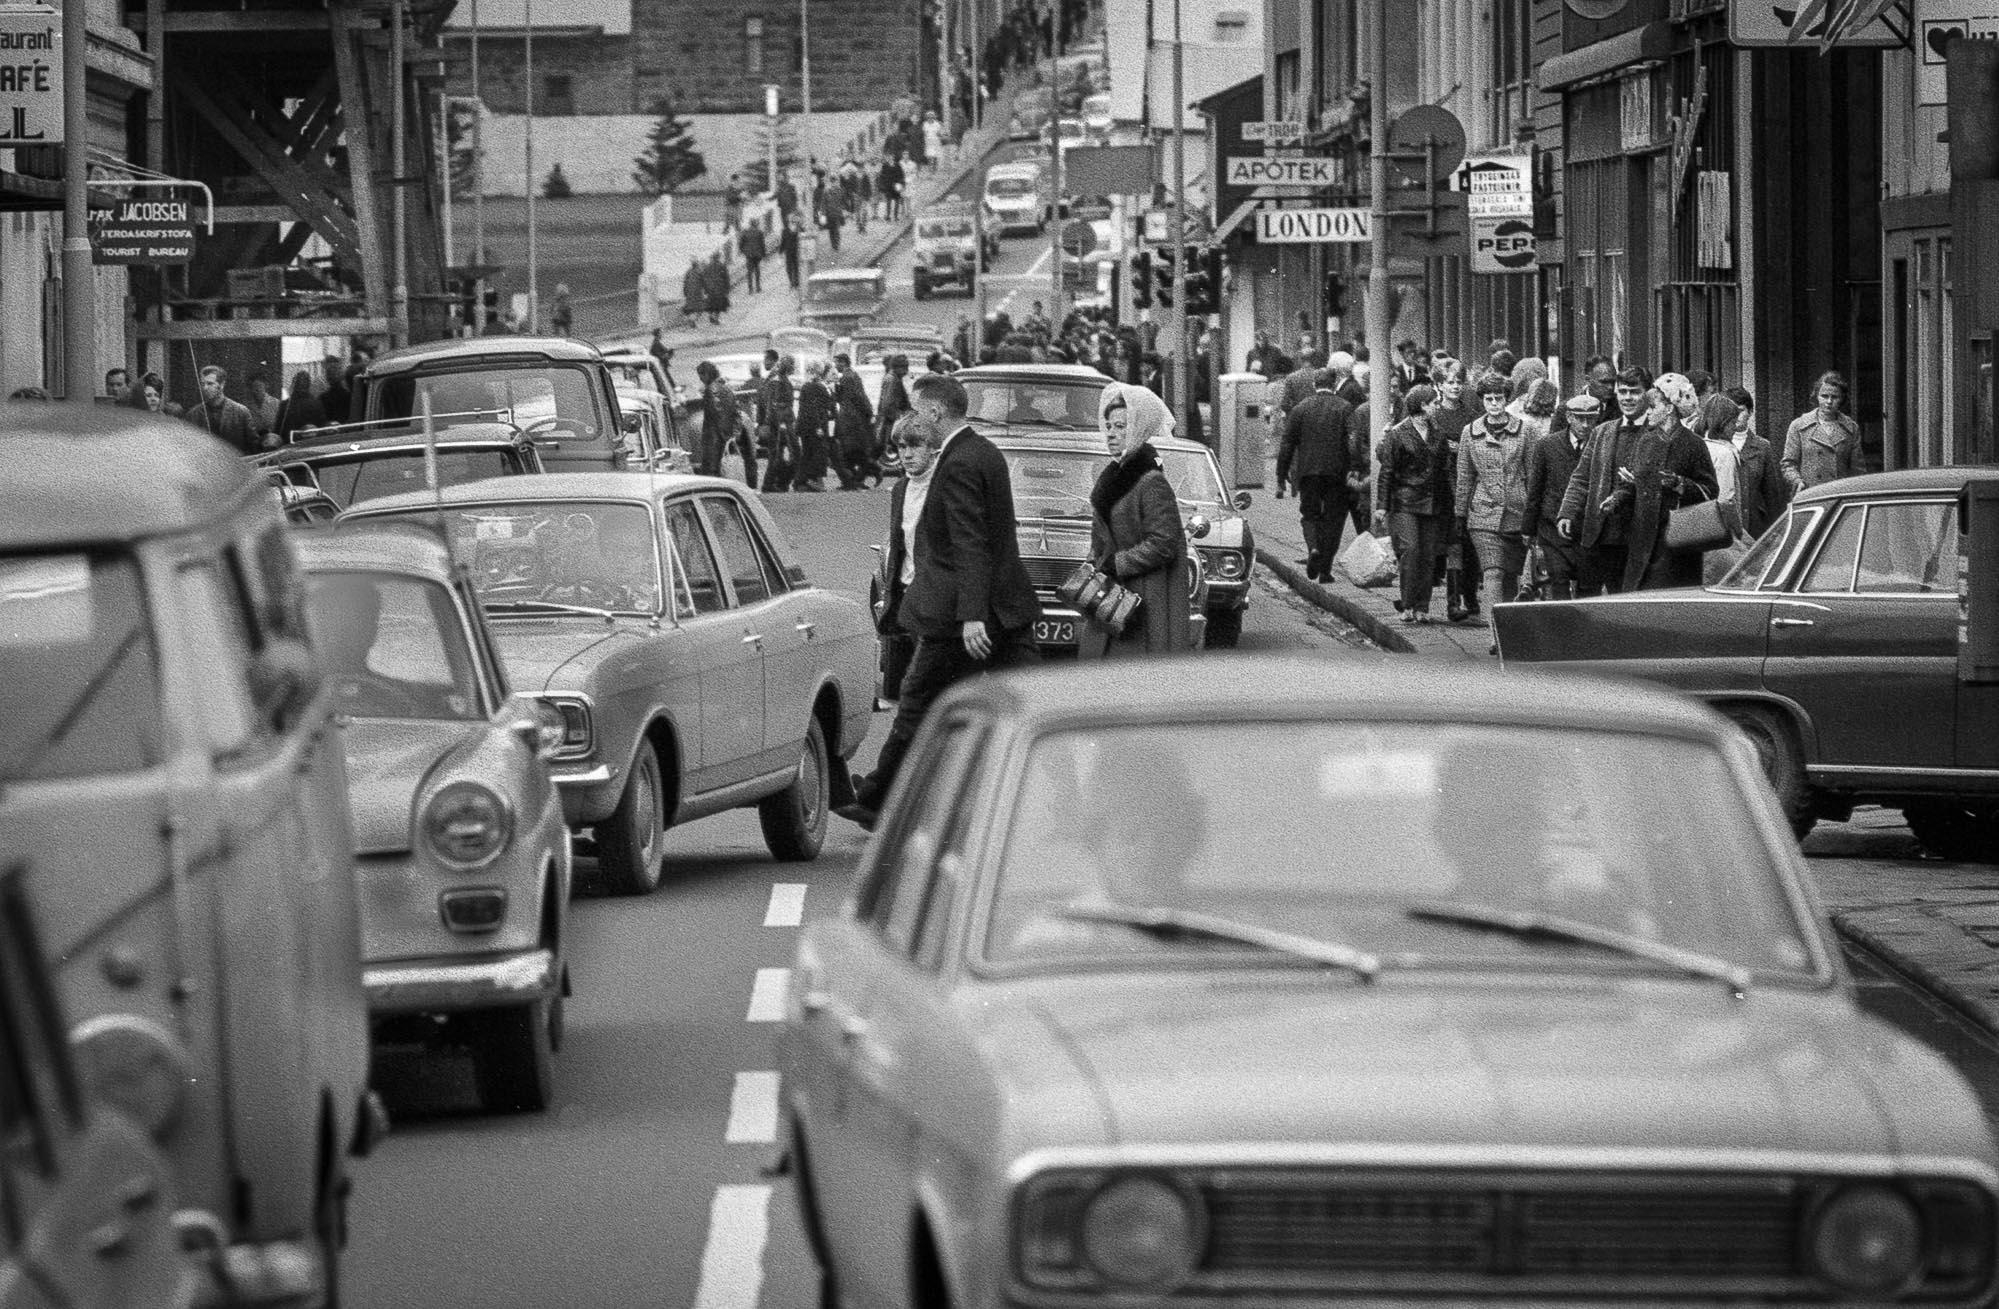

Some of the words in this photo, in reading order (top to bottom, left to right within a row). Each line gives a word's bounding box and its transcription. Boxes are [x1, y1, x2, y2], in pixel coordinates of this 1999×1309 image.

[0, 26, 54, 49] aurant
[1234, 157, 1329, 180] APÓTEK
[120, 202, 187, 221] JACOBSEN
[1264, 212, 1369, 238] LONDON
[102, 247, 141, 257] TOURIST
[148, 247, 189, 257] BUREAU
